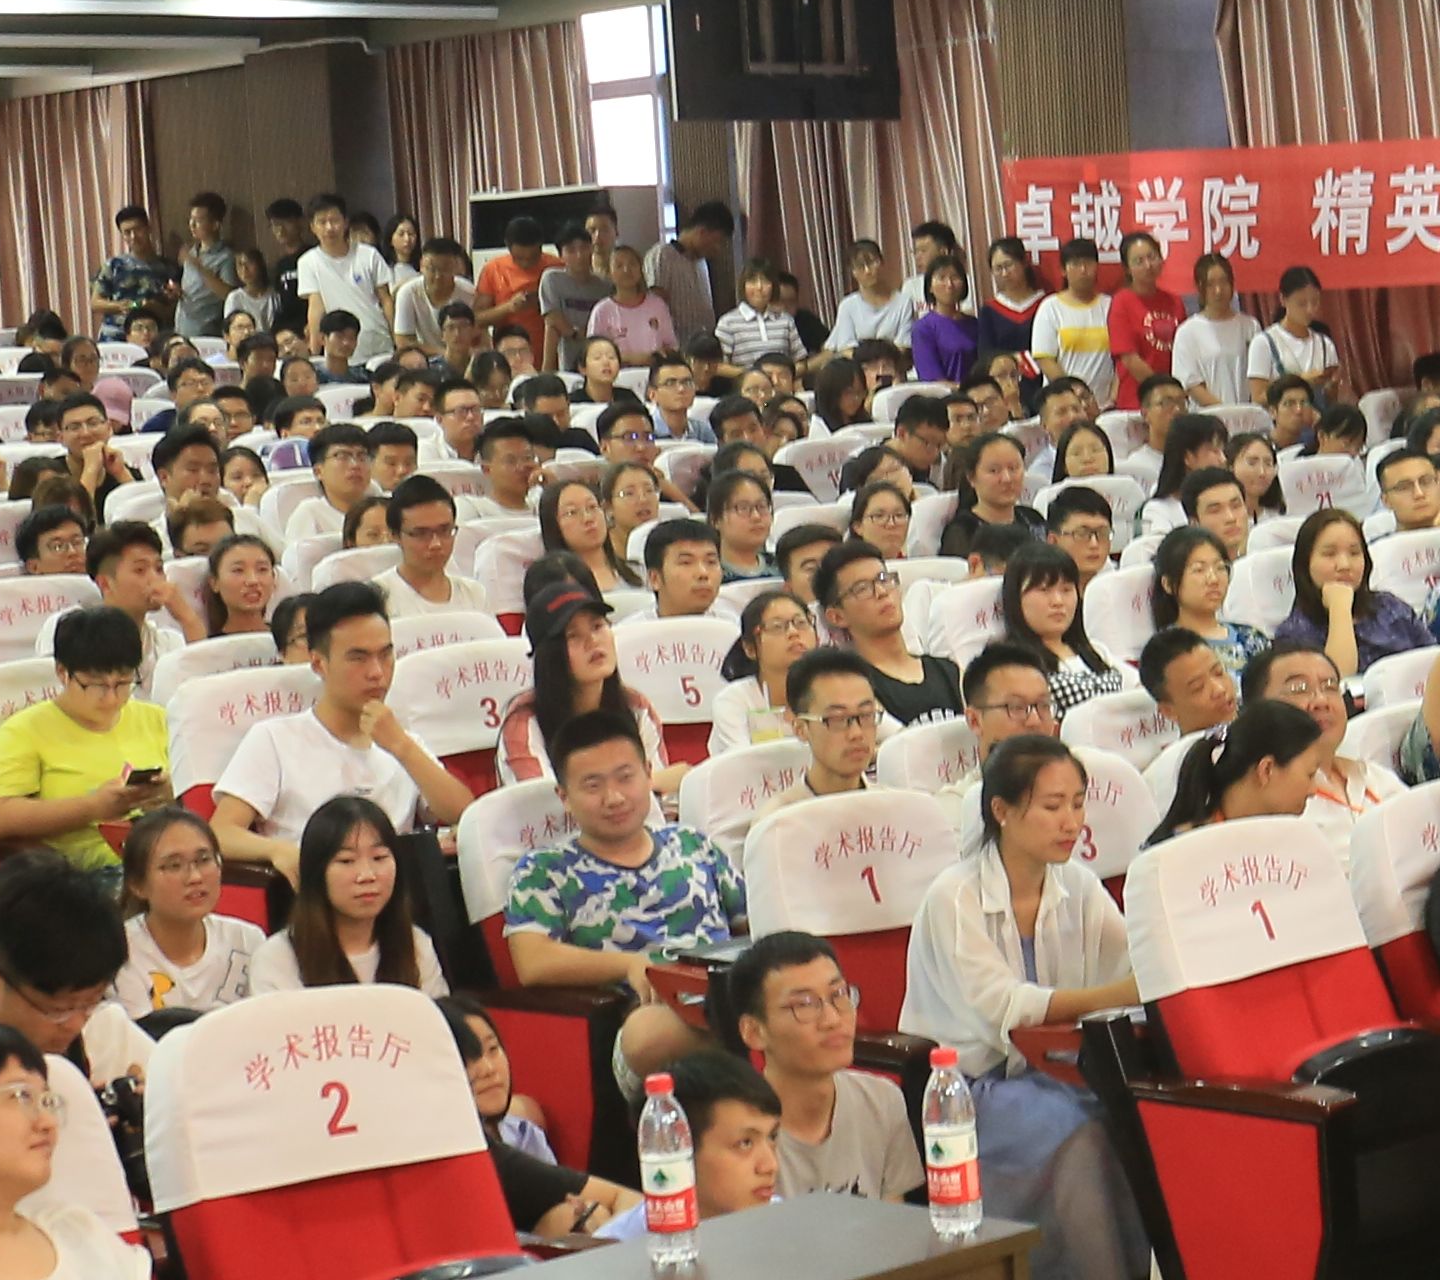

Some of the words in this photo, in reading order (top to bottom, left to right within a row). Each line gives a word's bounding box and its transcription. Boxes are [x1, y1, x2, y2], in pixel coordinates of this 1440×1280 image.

[1014, 175, 1260, 265] 卓越学院
[635, 642, 724, 674] 学术报告厅
[436, 659, 531, 699] 学术报告厅
[681, 676, 702, 708] 5
[219, 691, 317, 725] 学术报告
[479, 697, 501, 729] 3
[740, 768, 807, 810] 学术报
[814, 824, 922, 871] 学术报告厅
[1079, 824, 1099, 862] 3
[860, 865, 882, 905] 1
[1199, 854, 1309, 908] 学术报告厅
[1250, 899, 1277, 941] 1
[244, 1023, 412, 1093] 学术报告厅
[320, 1081, 358, 1137] 2
